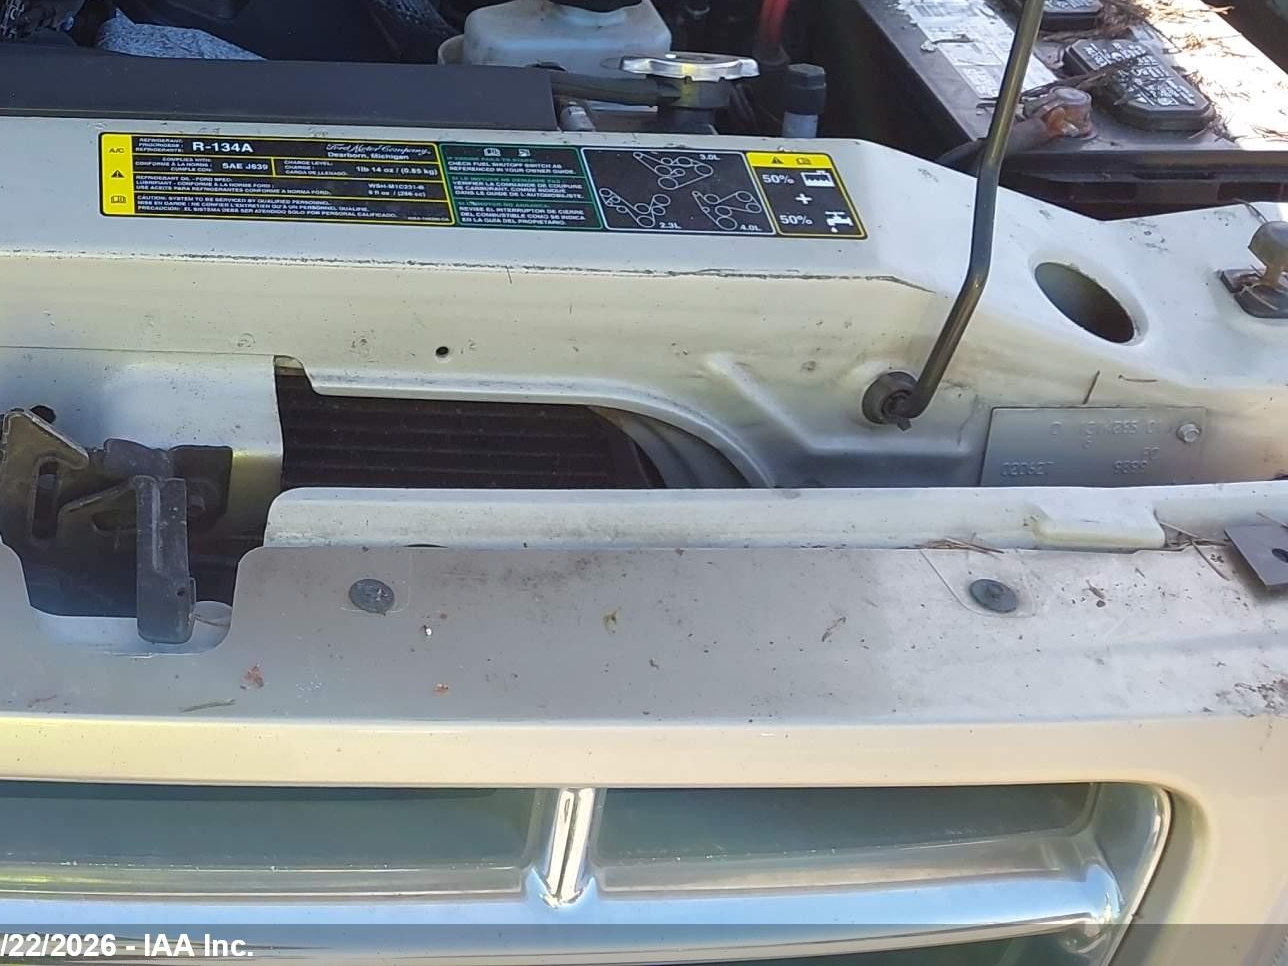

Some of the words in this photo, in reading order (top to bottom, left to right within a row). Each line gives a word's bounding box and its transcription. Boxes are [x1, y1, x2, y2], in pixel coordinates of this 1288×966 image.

[192, 141, 253, 153] R-134A
[325, 144, 351, 152] Ford
[351, 144, 379, 154] Motor
[328, 151, 370, 159] Dearborn,
[371, 152, 409, 161] Michigan
[699, 153, 721, 161] 3.0L
[222, 162, 243, 170] SAE
[371, 166, 381, 174] 14
[423, 167, 439, 177] kg)
[761, 174, 795, 185] 50%
[137, 194, 167, 202] CAUTION:
[795, 194, 812, 205] +
[496, 207, 546, 215] INTERRUPTOR
[659, 221, 682, 229] 2.3L
[779, 215, 813, 226] 50%
[739, 224, 763, 232] 4.0L
